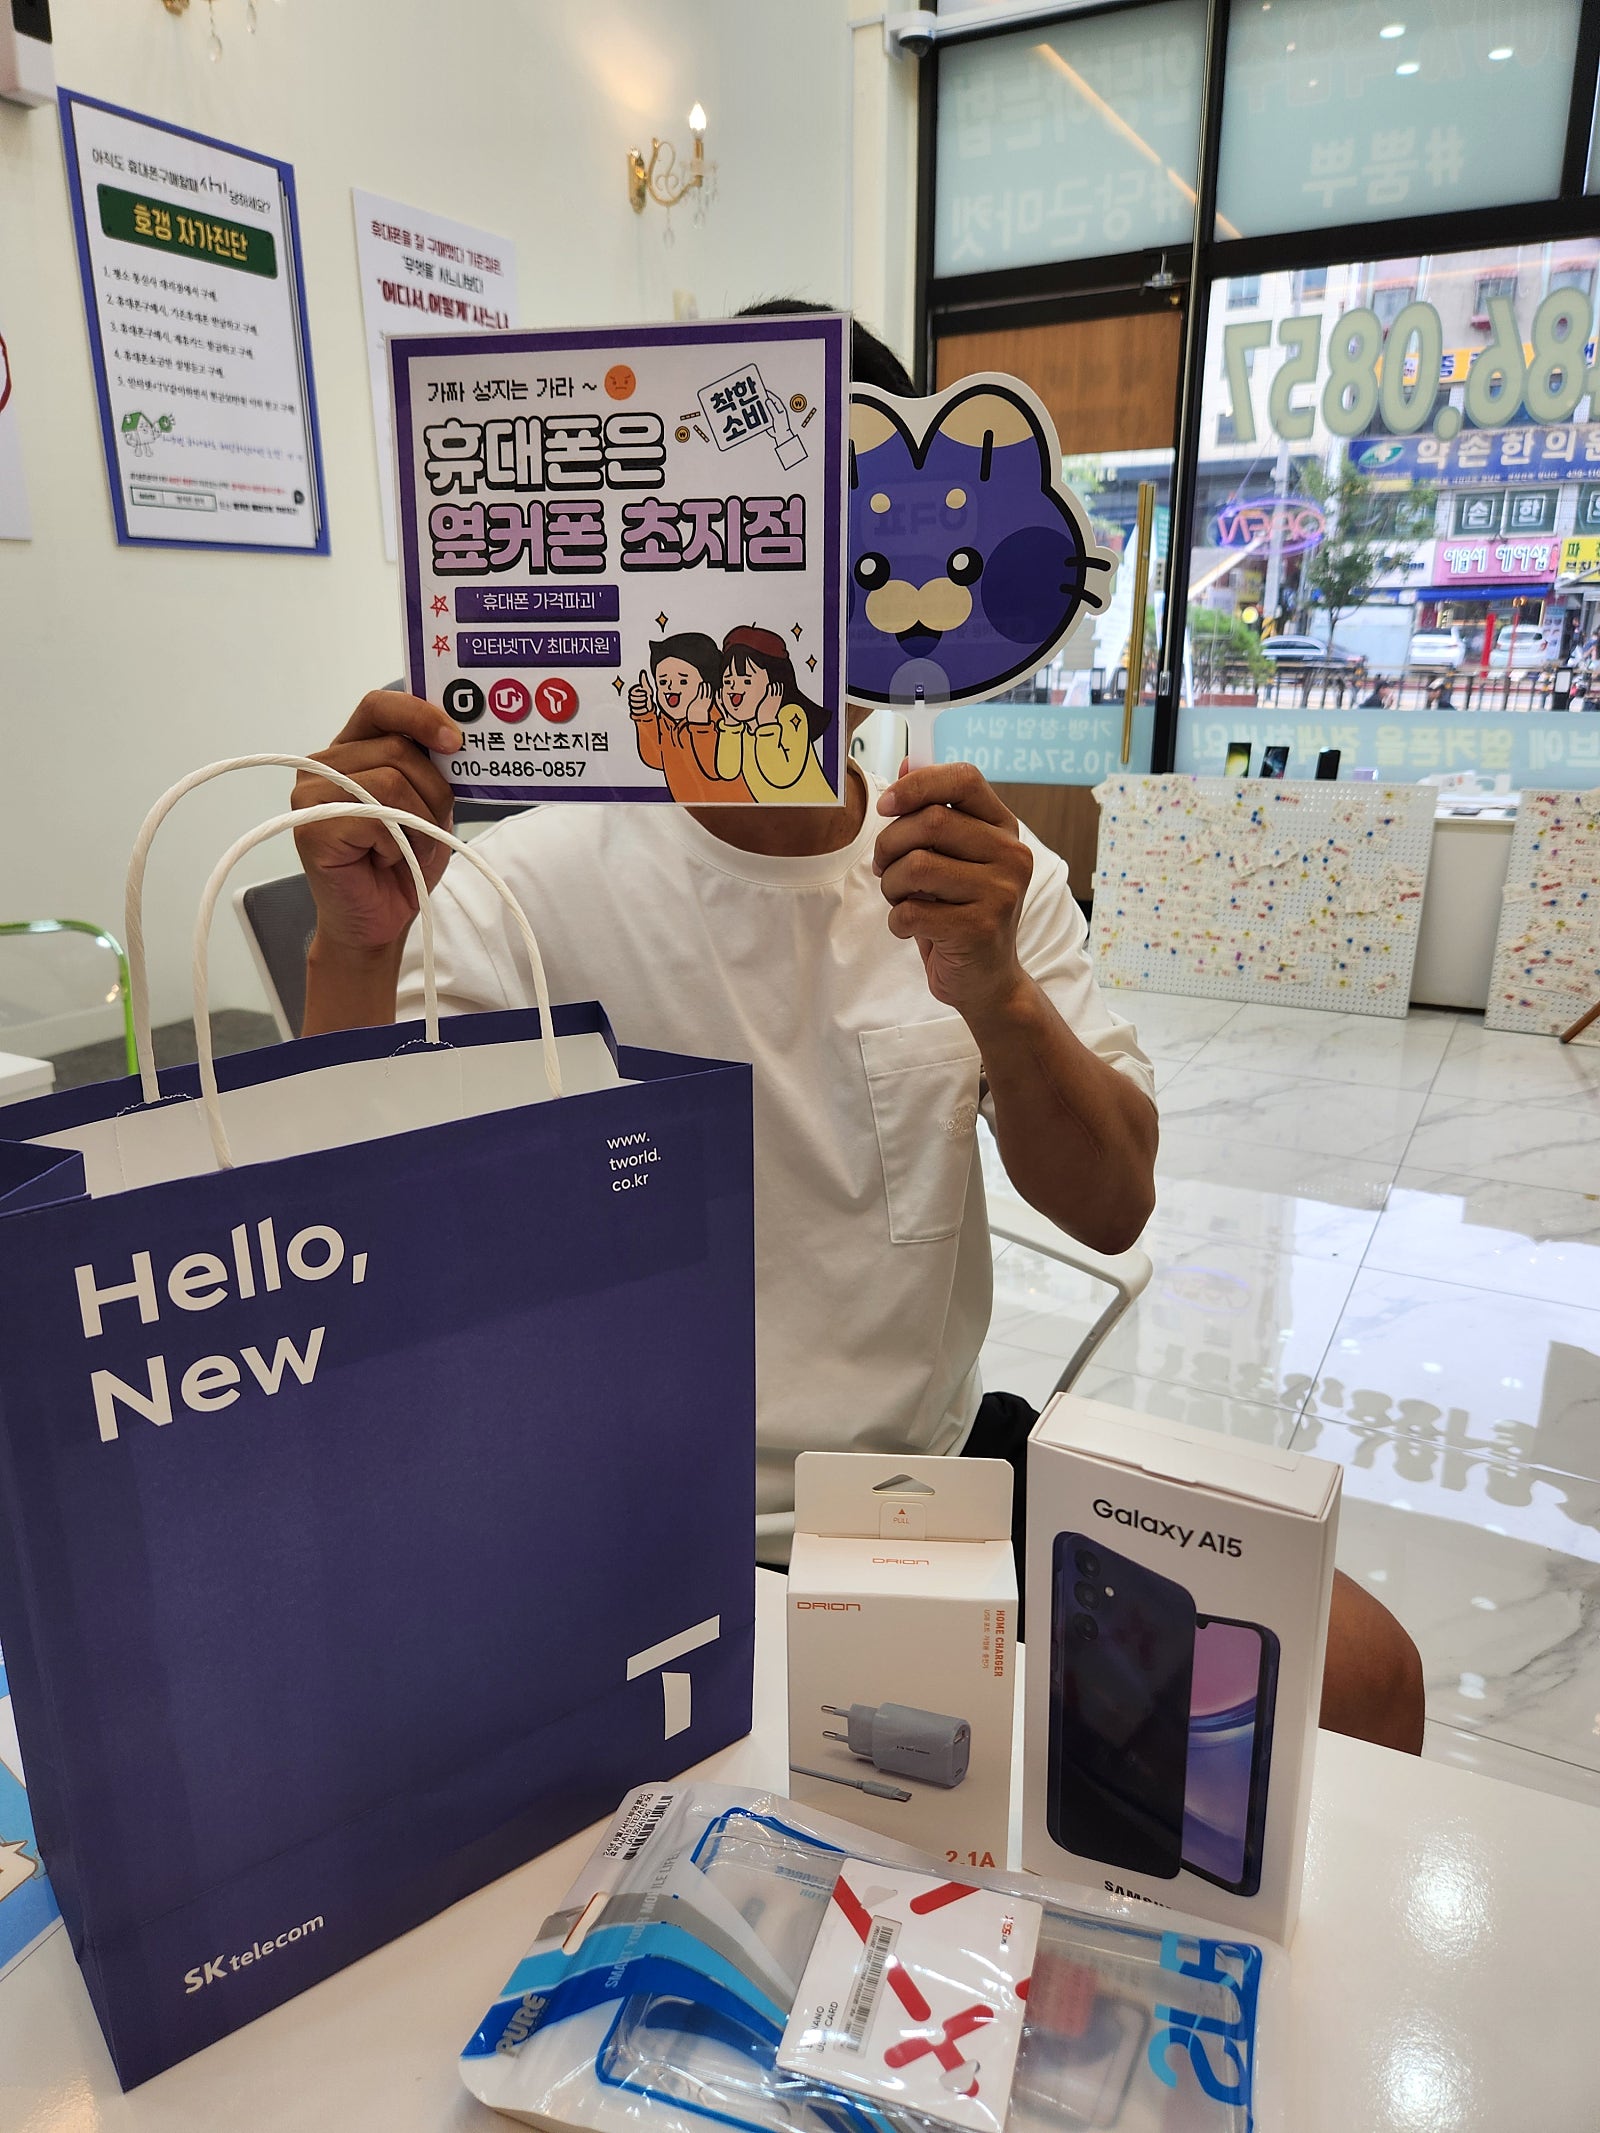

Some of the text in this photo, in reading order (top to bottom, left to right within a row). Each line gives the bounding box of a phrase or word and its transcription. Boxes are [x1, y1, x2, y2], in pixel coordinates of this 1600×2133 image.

[133, 202, 249, 262] 호갱 자가진단
[370, 218, 412, 249] 휴대폰을
[472, 304, 510, 330] 사느냐
[427, 381, 465, 403] 가짜
[472, 379, 529, 402] 성지는
[536, 376, 575, 399] 가라
[710, 376, 760, 414] 착한
[722, 400, 769, 442] 소비
[423, 412, 667, 495] 휴대폰은
[429, 500, 607, 577] 옆커폰
[620, 493, 807, 573] 초지점
[482, 591, 596, 611] 휴대폰 가격파괴
[471, 635, 610, 656] 인터넷TV 최대지원
[461, 731, 610, 752] 커폰 안산초지점
[451, 760, 587, 778] 010-8486-0857
[606, 1132, 650, 1150] www.
[609, 1147, 661, 1171] tworld.
[612, 1173, 649, 1192] co.kr
[74, 1216, 370, 1338] Hello,
[90, 1326, 326, 1442] New
[893, 1516, 910, 1525] PULL
[1092, 1498, 1243, 1558] Galaxy A15
[993, 1609, 1006, 1677] HOME CHARGER
[945, 1850, 997, 1869] 2.1A
[183, 1915, 325, 1994] SK telecom
[496, 1992, 547, 2059] PURE
[824, 2001, 839, 2027] CARD
